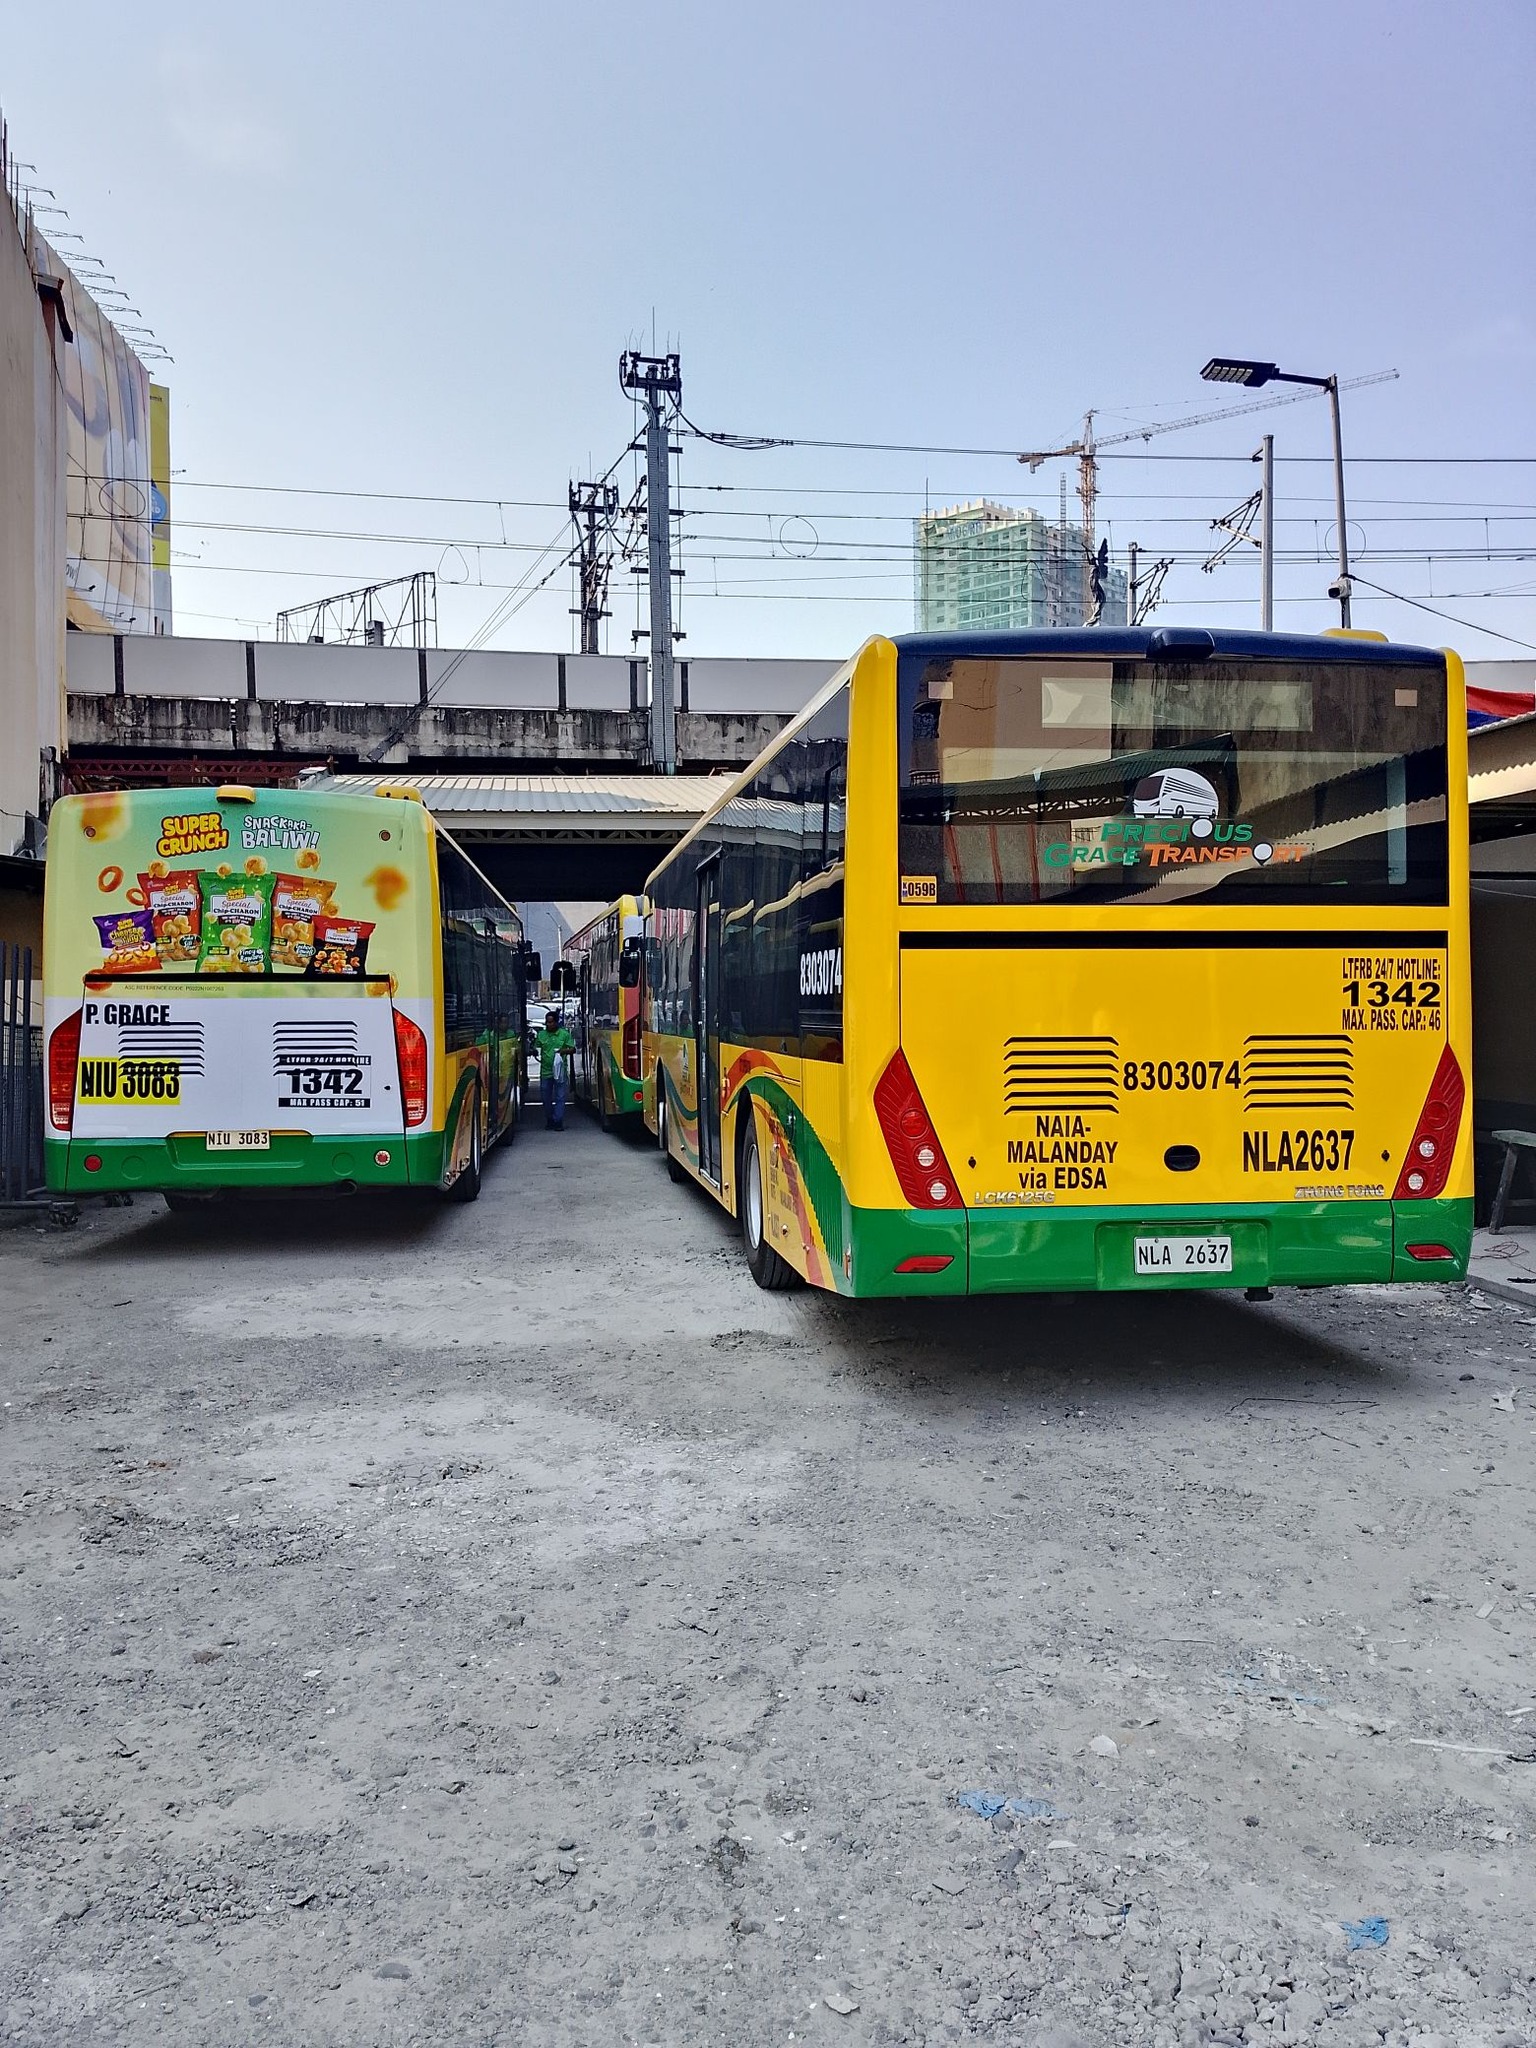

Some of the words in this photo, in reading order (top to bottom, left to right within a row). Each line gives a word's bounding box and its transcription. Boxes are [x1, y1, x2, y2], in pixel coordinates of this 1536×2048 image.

[162, 813, 221, 836] SUPER
[244, 815, 313, 830] SNACKAKA-
[1101, 819, 1253, 842] PRECIOUS
[157, 830, 228, 857] CRUNCH
[241, 829, 320, 849] BALIW!
[1044, 843, 1142, 867] GRACE
[1144, 843, 1308, 867] TRANSPORT
[908, 881, 935, 897] 059B
[221, 900, 251, 909] Special
[800, 947, 842, 995] 8303074
[1342, 958, 1372, 979] LTFRB
[1375, 958, 1394, 979] 24/7
[1396, 958, 1441, 980] HOTLINE:
[1342, 981, 1441, 1007] 1342
[85, 1003, 99, 1025] P.
[104, 1003, 170, 1026] GRACE
[1342, 1009, 1367, 1030] MAX.
[1370, 1009, 1399, 1031] PASS.
[1428, 1009, 1441, 1031] 46
[81, 1061, 118, 1098] NIU
[122, 1061, 180, 1099] 3083
[286, 1068, 363, 1094] 1342
[1122, 1060, 1241, 1091] 8303074
[289, 1098, 307, 1106] MAX
[310, 1098, 331, 1106] PASS
[334, 1098, 353, 1106] CAP:
[1036, 1115, 1091, 1138] NAIA-
[208, 1132, 231, 1145] NIU
[238, 1132, 268, 1145] 3083
[1007, 1140, 1118, 1164] MALANDAY
[1243, 1130, 1355, 1172] NLA2637
[1018, 1167, 1048, 1189] via
[1054, 1167, 1107, 1189] EDSA
[974, 1190, 1056, 1205] LCK6125G
[1294, 1185, 1345, 1199] ZHONG
[1346, 1184, 1385, 1198] TONG
[1138, 1244, 1172, 1266] NLA
[1185, 1244, 1229, 1265] 2637
